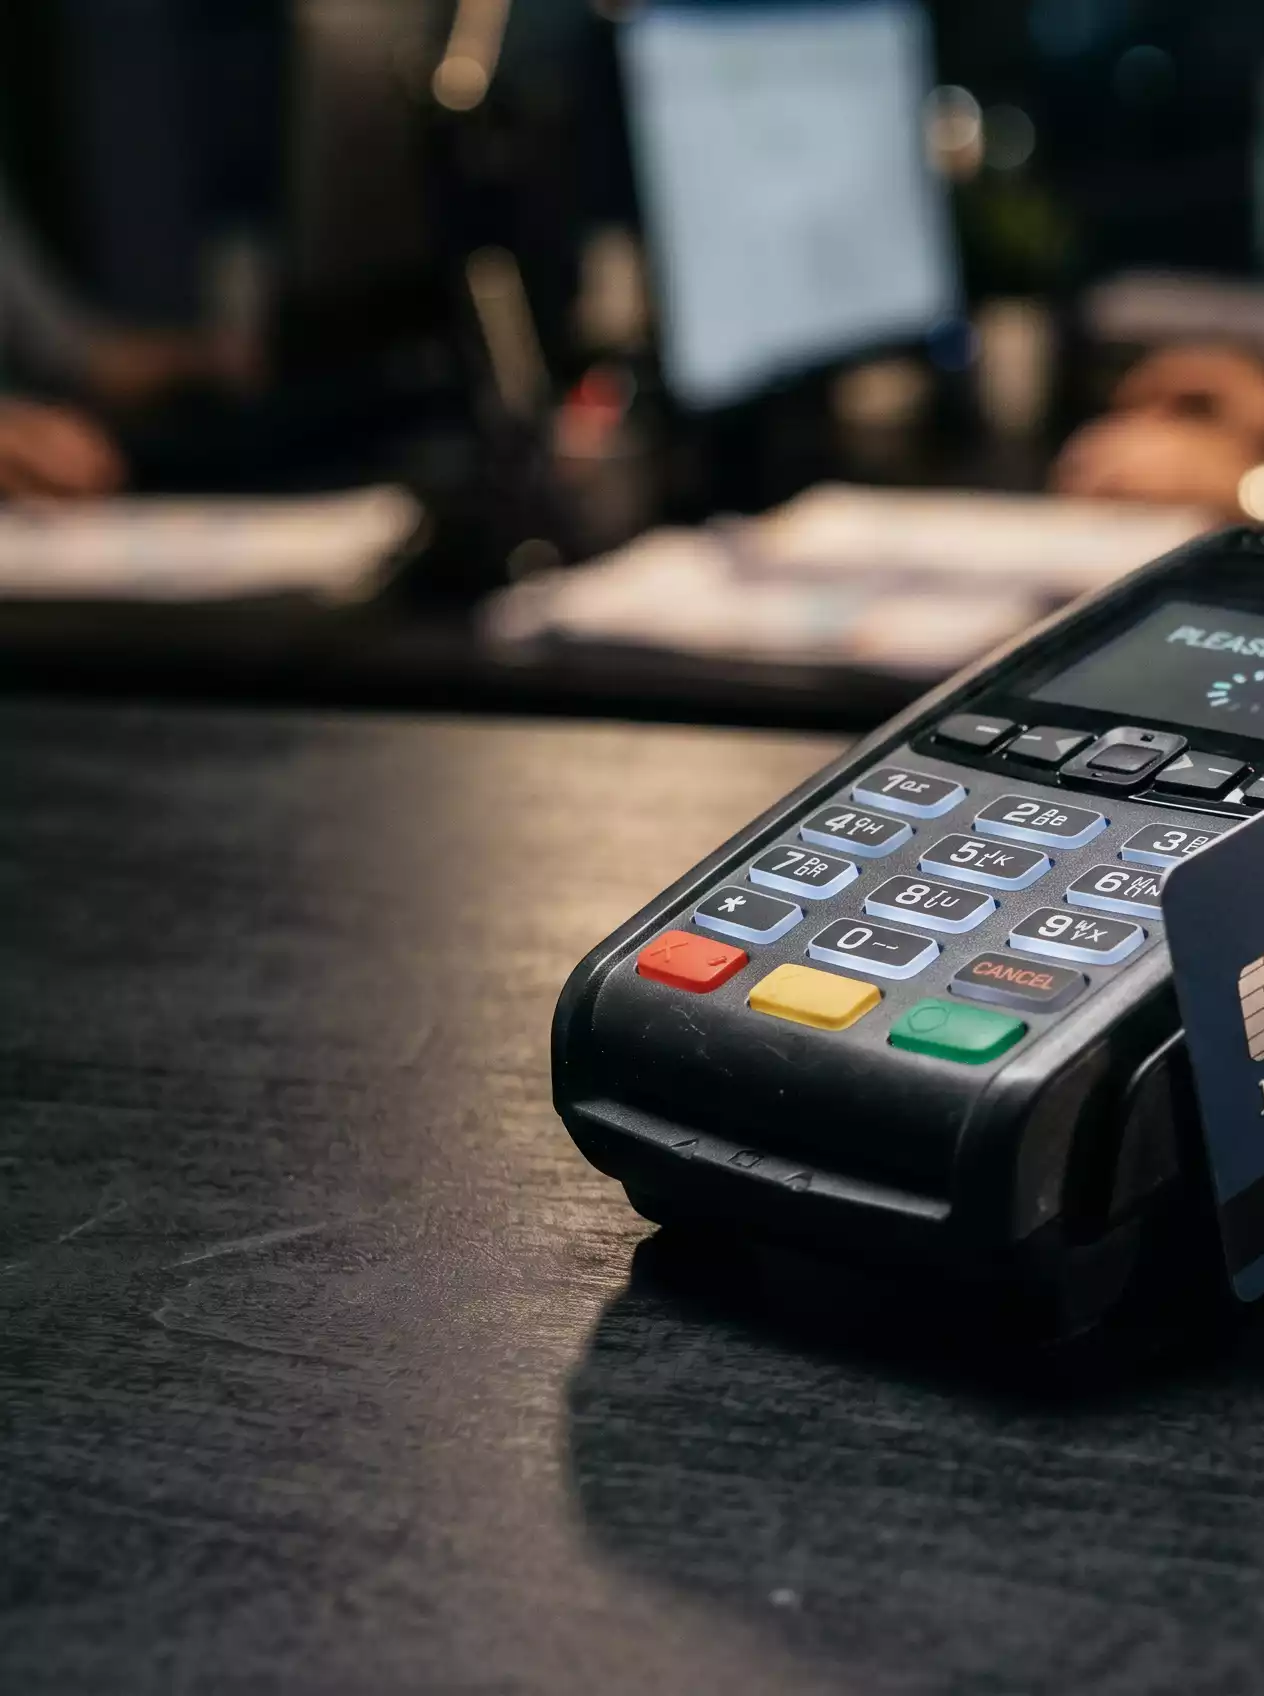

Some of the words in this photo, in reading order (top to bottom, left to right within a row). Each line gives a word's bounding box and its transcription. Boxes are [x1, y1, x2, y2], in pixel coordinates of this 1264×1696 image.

[882, 773, 908, 793] 1
[824, 812, 858, 833] 4
[1002, 802, 1041, 824] 2
[949, 840, 986, 864] 5
[1152, 830, 1188, 852] 3
[771, 850, 806, 872] 7
[1093, 870, 1131, 893] 6
[894, 883, 931, 906] 8
[1037, 914, 1074, 938] 9
[835, 926, 874, 950] 0
[971, 960, 1055, 991] CANCEL
